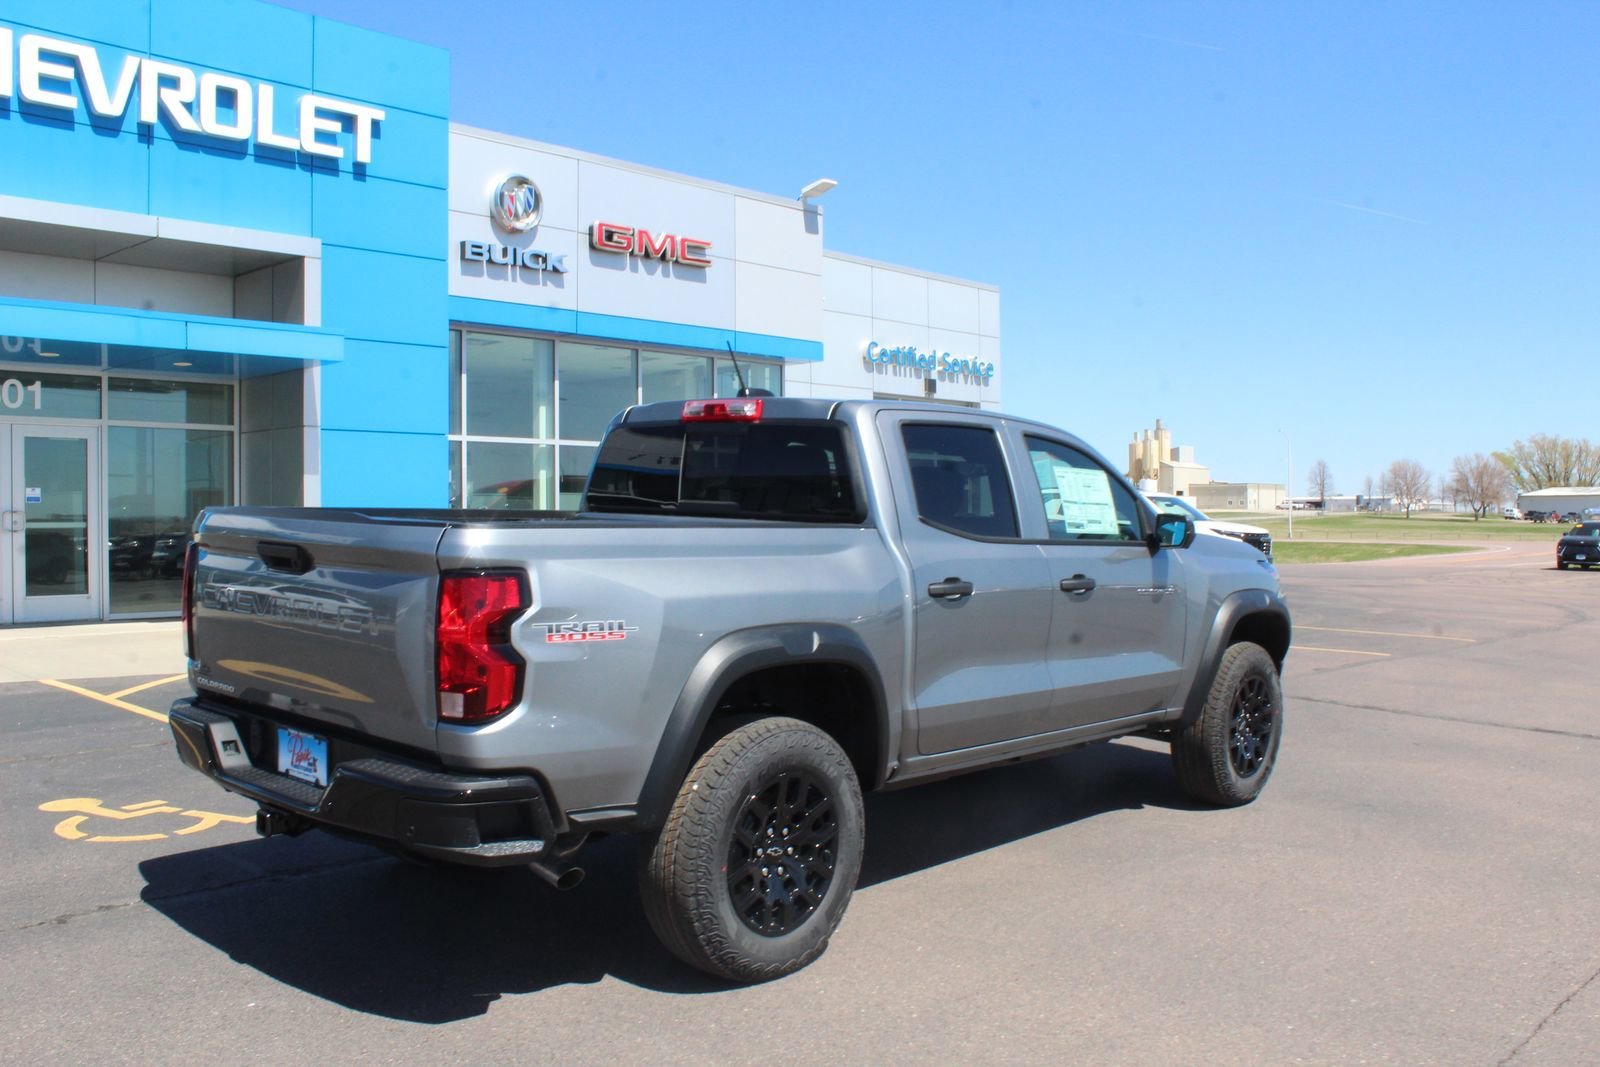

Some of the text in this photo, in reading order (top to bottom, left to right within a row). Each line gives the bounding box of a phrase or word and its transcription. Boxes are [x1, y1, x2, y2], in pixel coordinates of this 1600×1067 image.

[0, 27, 385, 164] EVROLET
[460, 239, 569, 274] BUICK
[590, 219, 713, 268] GMC
[866, 340, 994, 378] Certified Service
[1, 378, 42, 410] 01
[203, 586, 379, 636] CHEVROLET
[532, 619, 640, 633] TRAIL
[546, 631, 627, 643] BOSS
